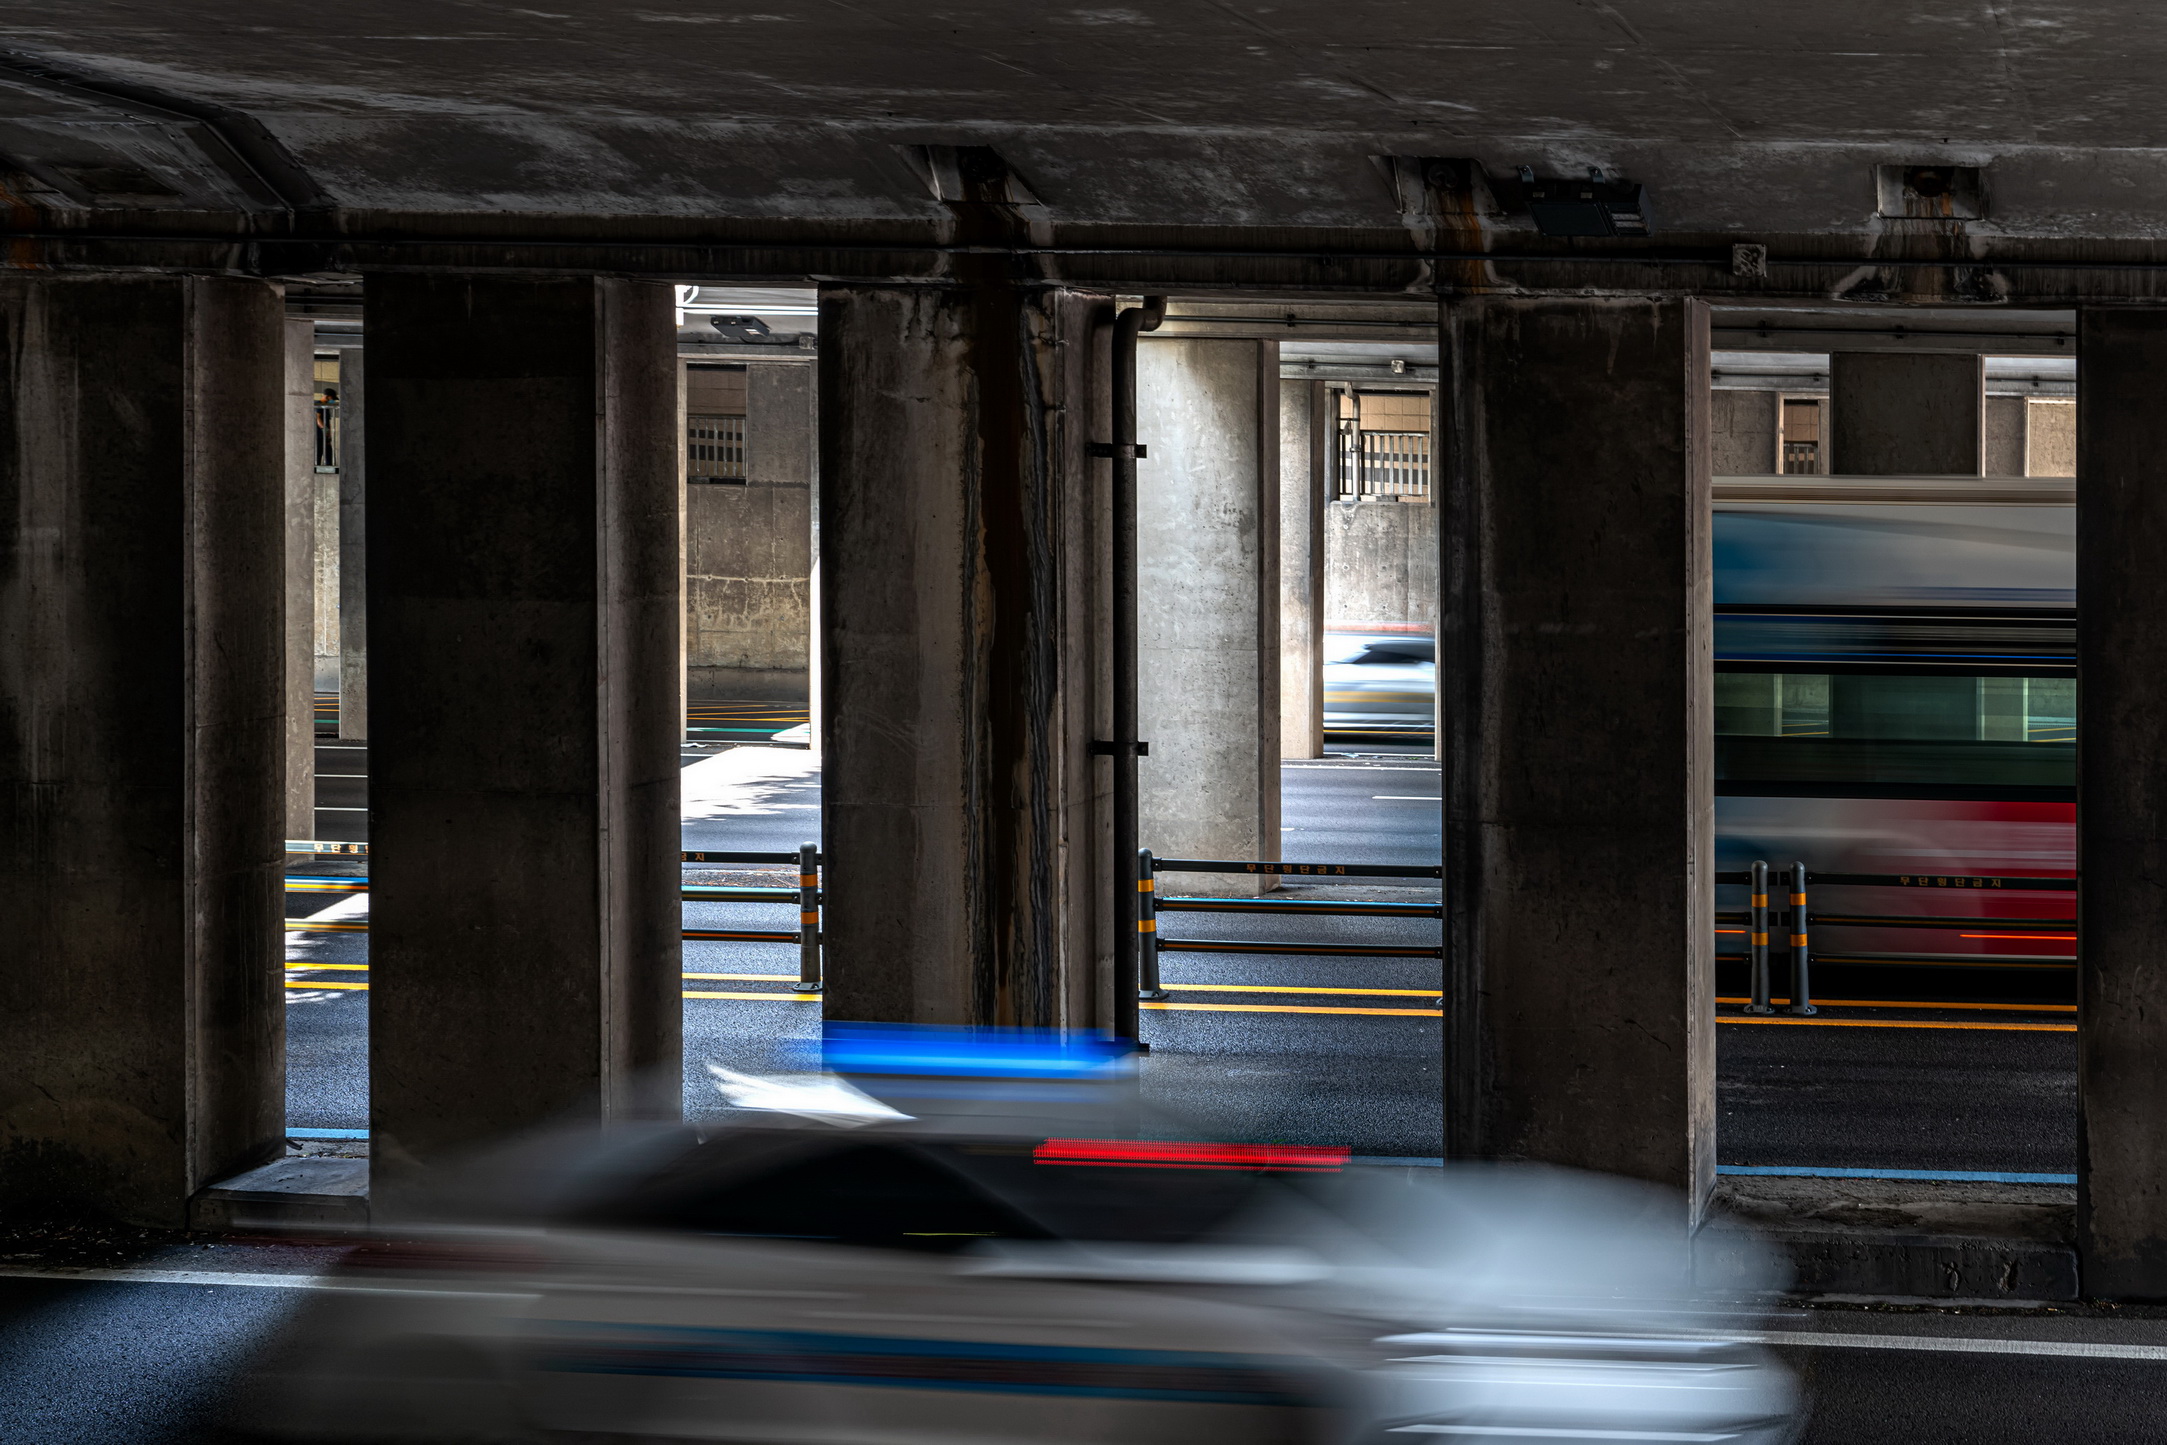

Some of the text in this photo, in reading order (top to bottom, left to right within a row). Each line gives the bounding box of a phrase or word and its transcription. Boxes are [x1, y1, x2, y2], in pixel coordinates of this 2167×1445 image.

[314, 843, 368, 854] 무단횡
[1246, 863, 1345, 875] 무단횡단금지
[1900, 876, 2001, 888] 무단횡단금지
